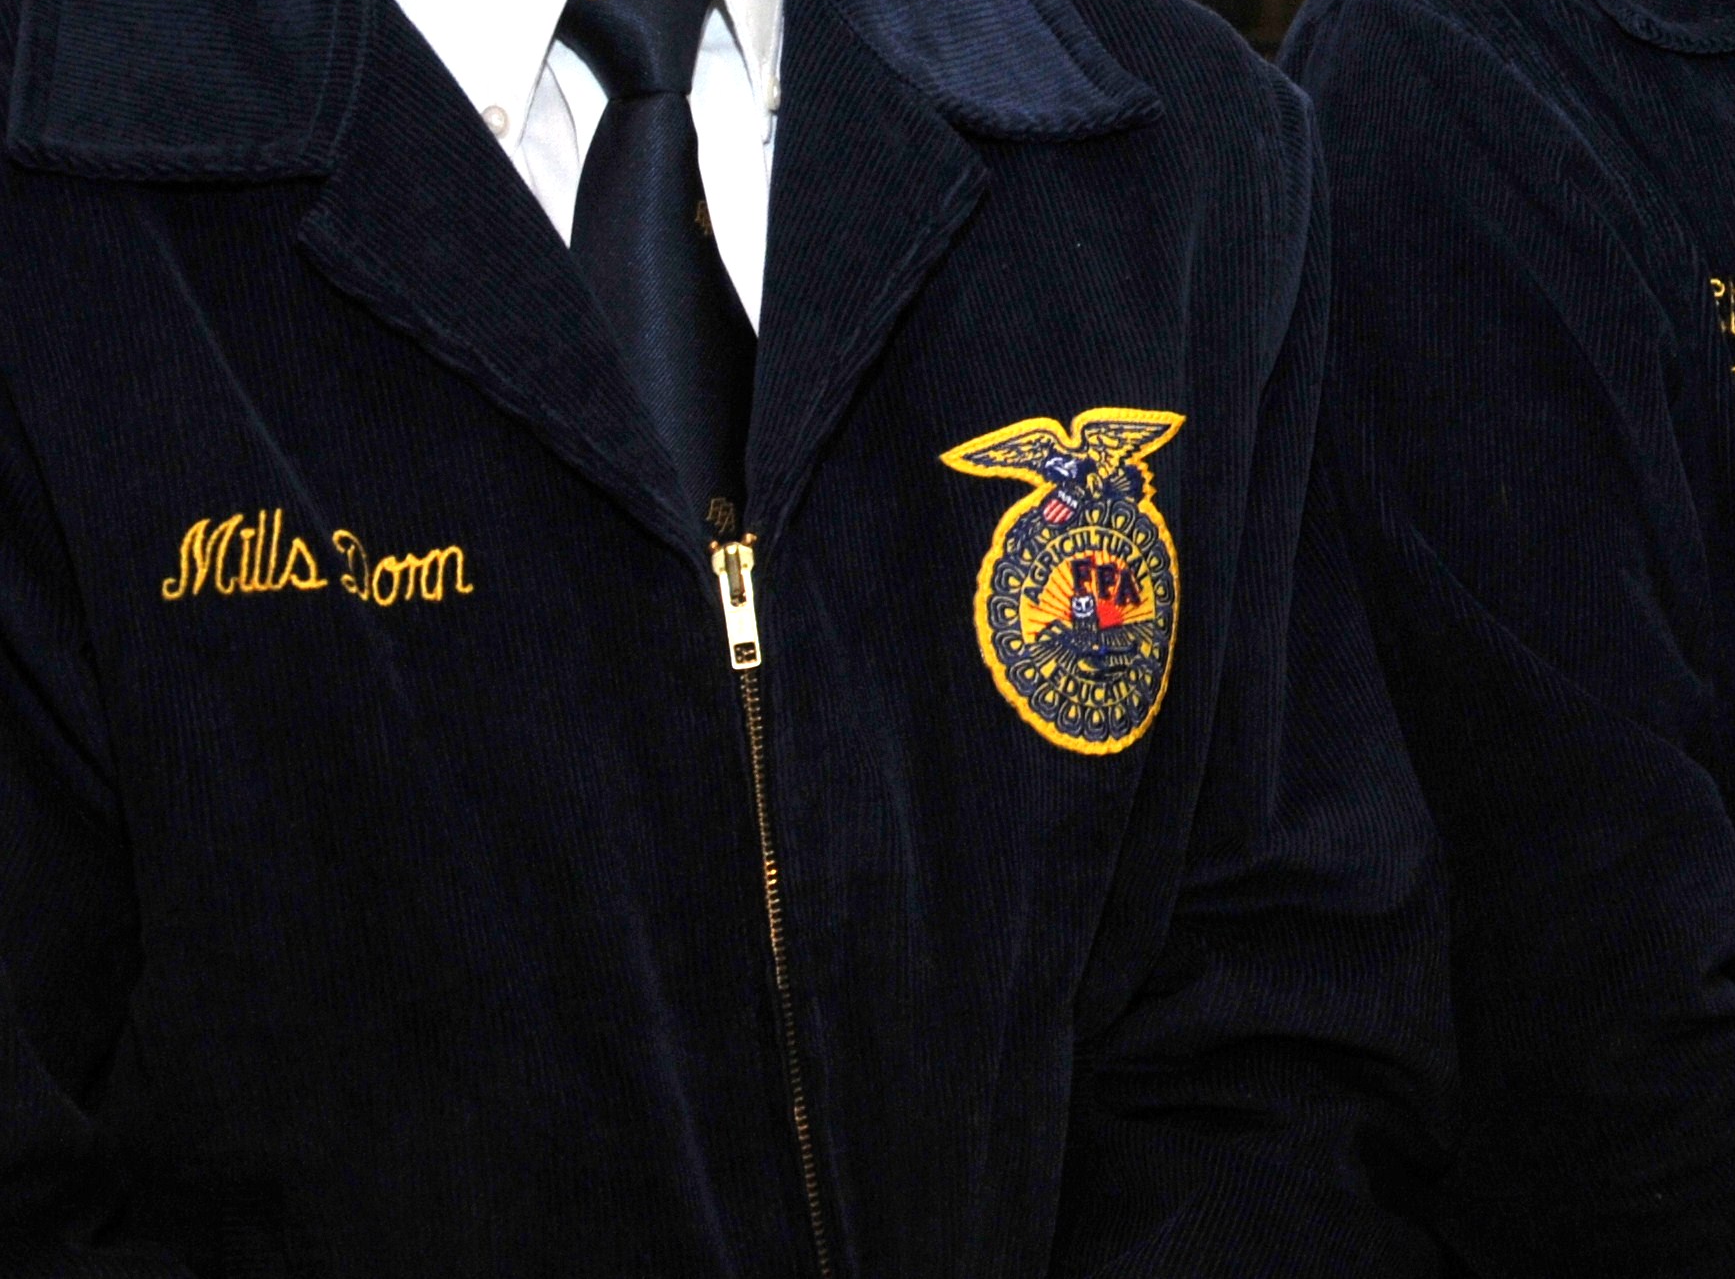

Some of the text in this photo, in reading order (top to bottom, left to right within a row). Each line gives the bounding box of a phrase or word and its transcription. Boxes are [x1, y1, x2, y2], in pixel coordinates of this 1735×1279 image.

[162, 508, 474, 607] Mills Dorn
[1024, 529, 1149, 605] AGRICULTURAL
[1071, 557, 1142, 605] FFA
